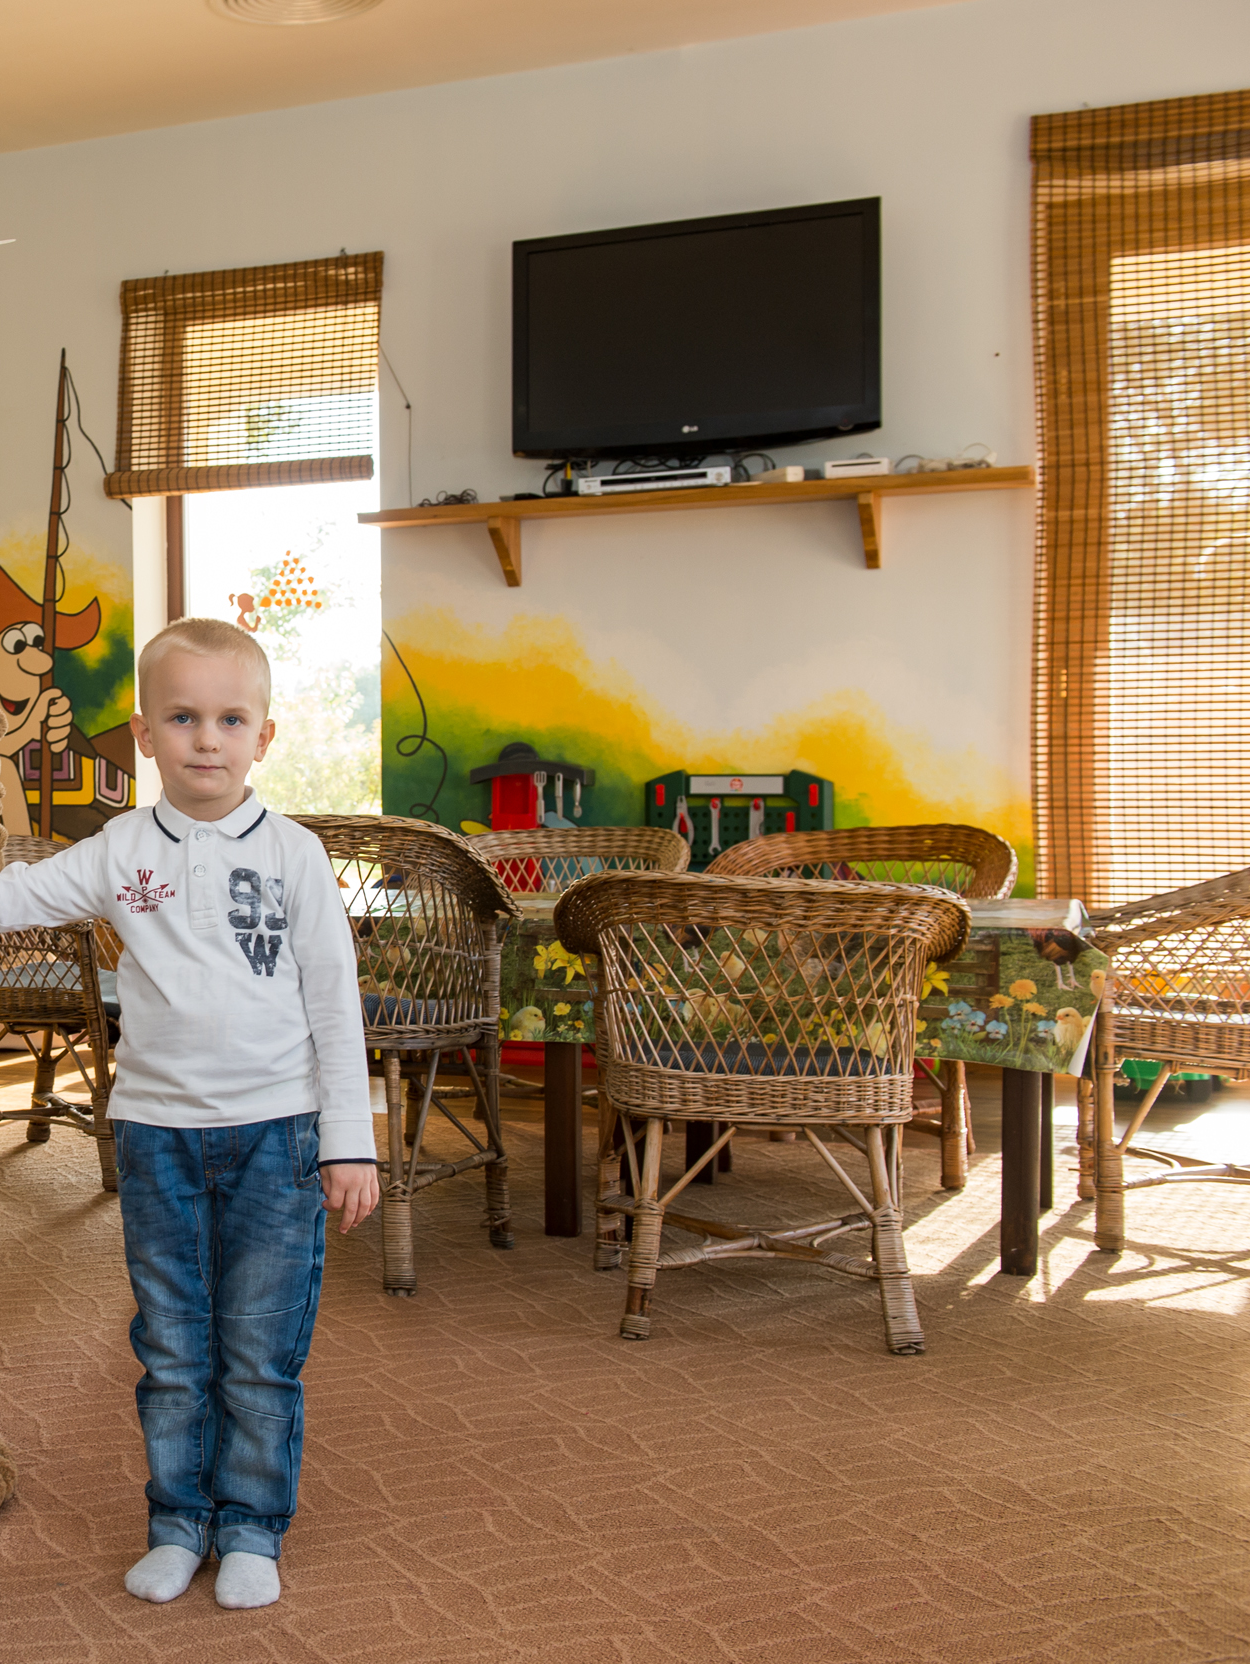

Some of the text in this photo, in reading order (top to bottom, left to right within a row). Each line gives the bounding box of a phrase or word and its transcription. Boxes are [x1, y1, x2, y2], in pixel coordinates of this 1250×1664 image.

[136, 868, 154, 886] W
[116, 889, 175, 902] WILD TEAM
[141, 886, 148, 894] P
[130, 903, 159, 914] COMPANY
[235, 932, 283, 978] W
